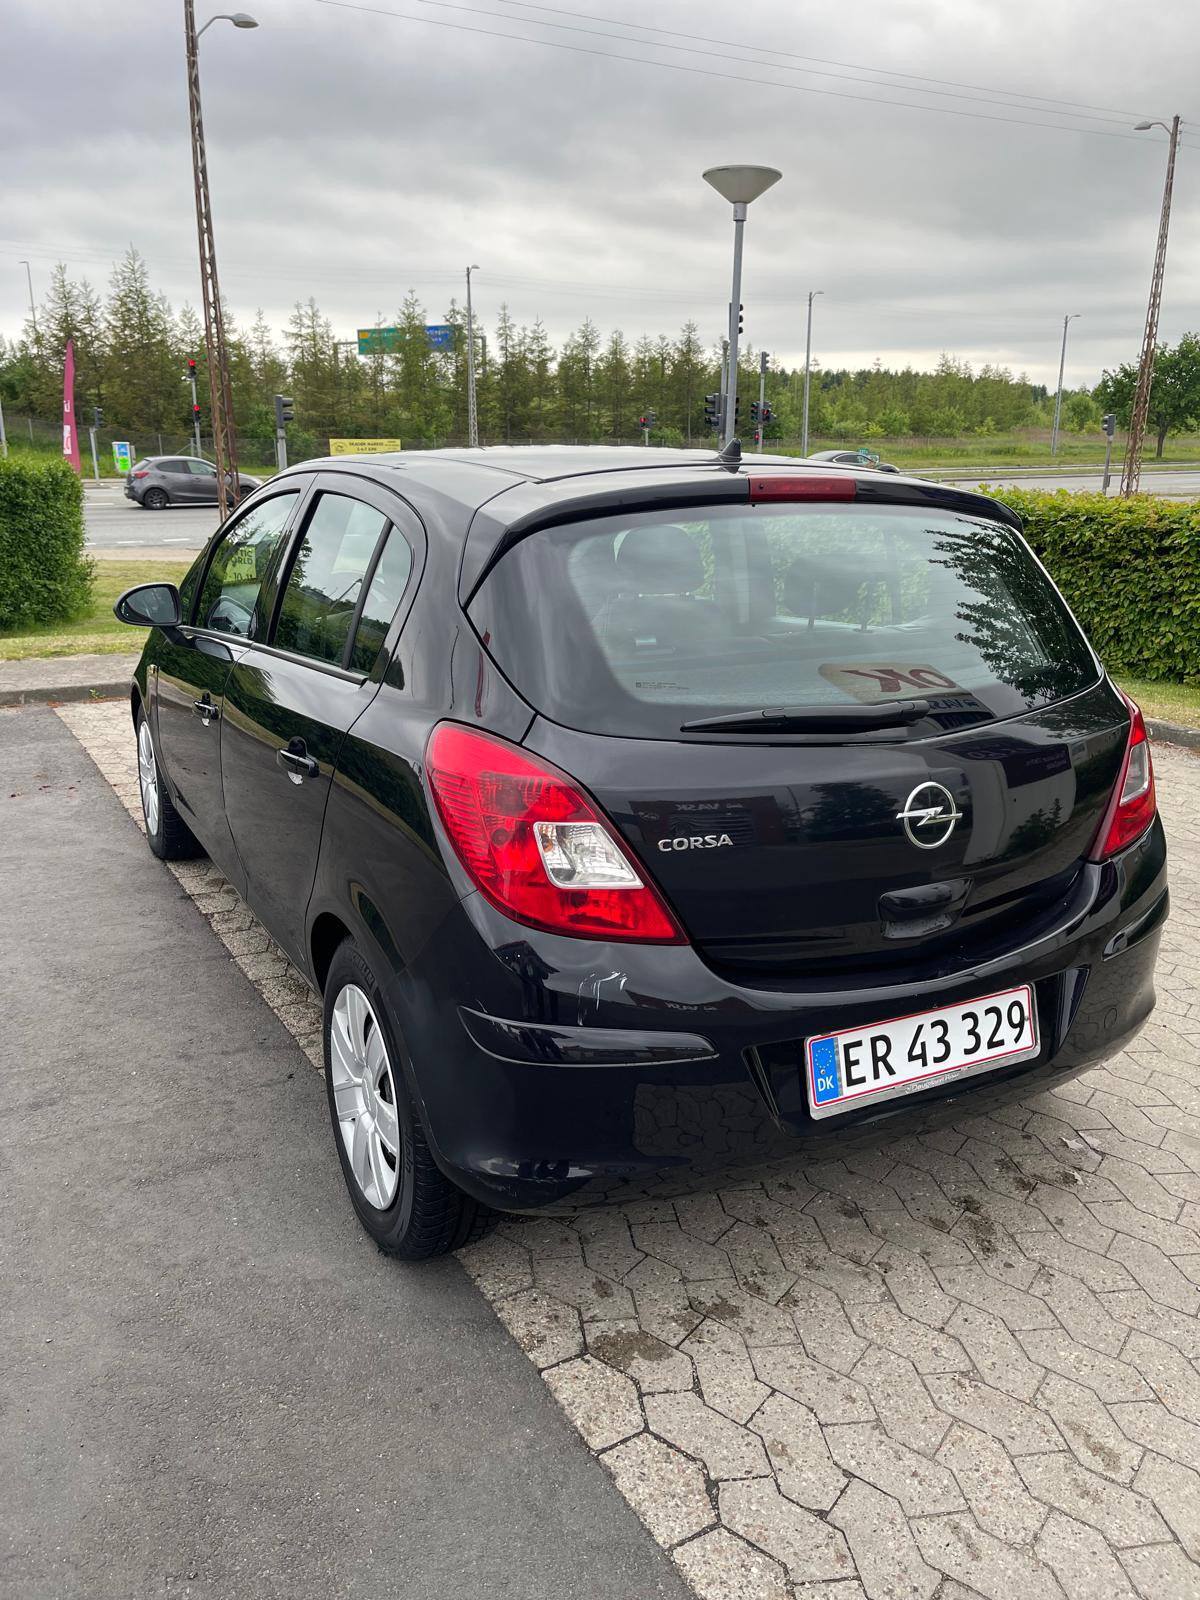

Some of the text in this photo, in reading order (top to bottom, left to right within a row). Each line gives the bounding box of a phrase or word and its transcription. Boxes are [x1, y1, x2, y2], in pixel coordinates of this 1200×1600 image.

[231, 556, 253, 565] ORLD
[657, 834, 734, 852] CORSA
[843, 1034, 896, 1087] ER
[907, 1019, 951, 1067] 43
[961, 1000, 1026, 1055] 329
[817, 1077, 835, 1092] DK
